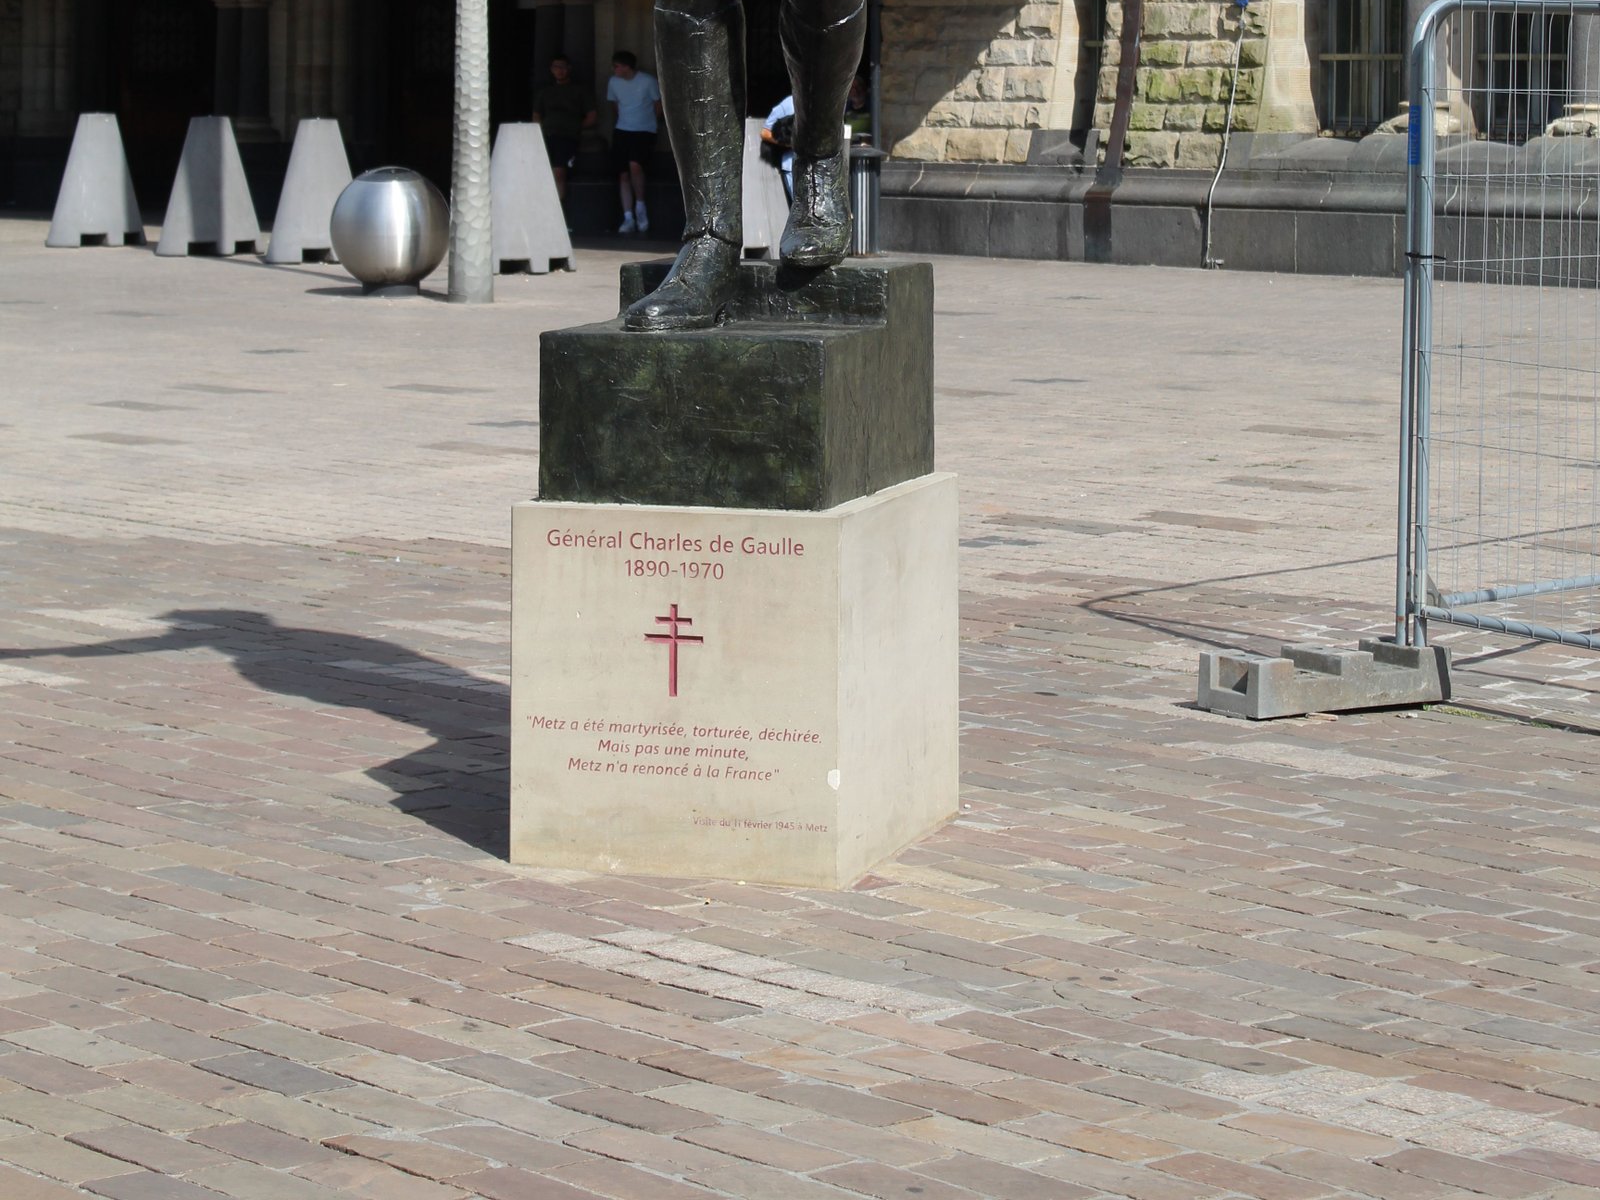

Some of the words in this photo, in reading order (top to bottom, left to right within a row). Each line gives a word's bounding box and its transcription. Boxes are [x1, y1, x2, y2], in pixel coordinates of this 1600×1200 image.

[546, 529, 623, 549] Général
[629, 532, 703, 552] Charles
[709, 535, 734, 553] de
[741, 537, 805, 556] Gaulle
[624, 559, 725, 580] 1890-1970
[526, 715, 566, 730] "Metz
[570, 720, 579, 731] a
[583, 718, 605, 732] été
[608, 722, 687, 738] martyrisée,
[693, 725, 753, 741] torturée,
[758, 728, 822, 744] déchirée.
[597, 739, 631, 753] Mais
[634, 744, 660, 757] pas
[664, 745, 691, 757] une
[695, 745, 749, 761] minute,
[568, 757, 602, 772] Metz
[606, 760, 628, 773] n'a
[632, 763, 689, 776] renoncé
[693, 764, 702, 778] à
[706, 765, 720, 778] la
[725, 766, 780, 781] France"
[692, 816, 717, 827] Visite
[719, 818, 731, 828] du
[743, 819, 772, 830] février
[775, 821, 795, 831] 1945
[797, 821, 803, 831] à
[805, 823, 829, 833] Metz
